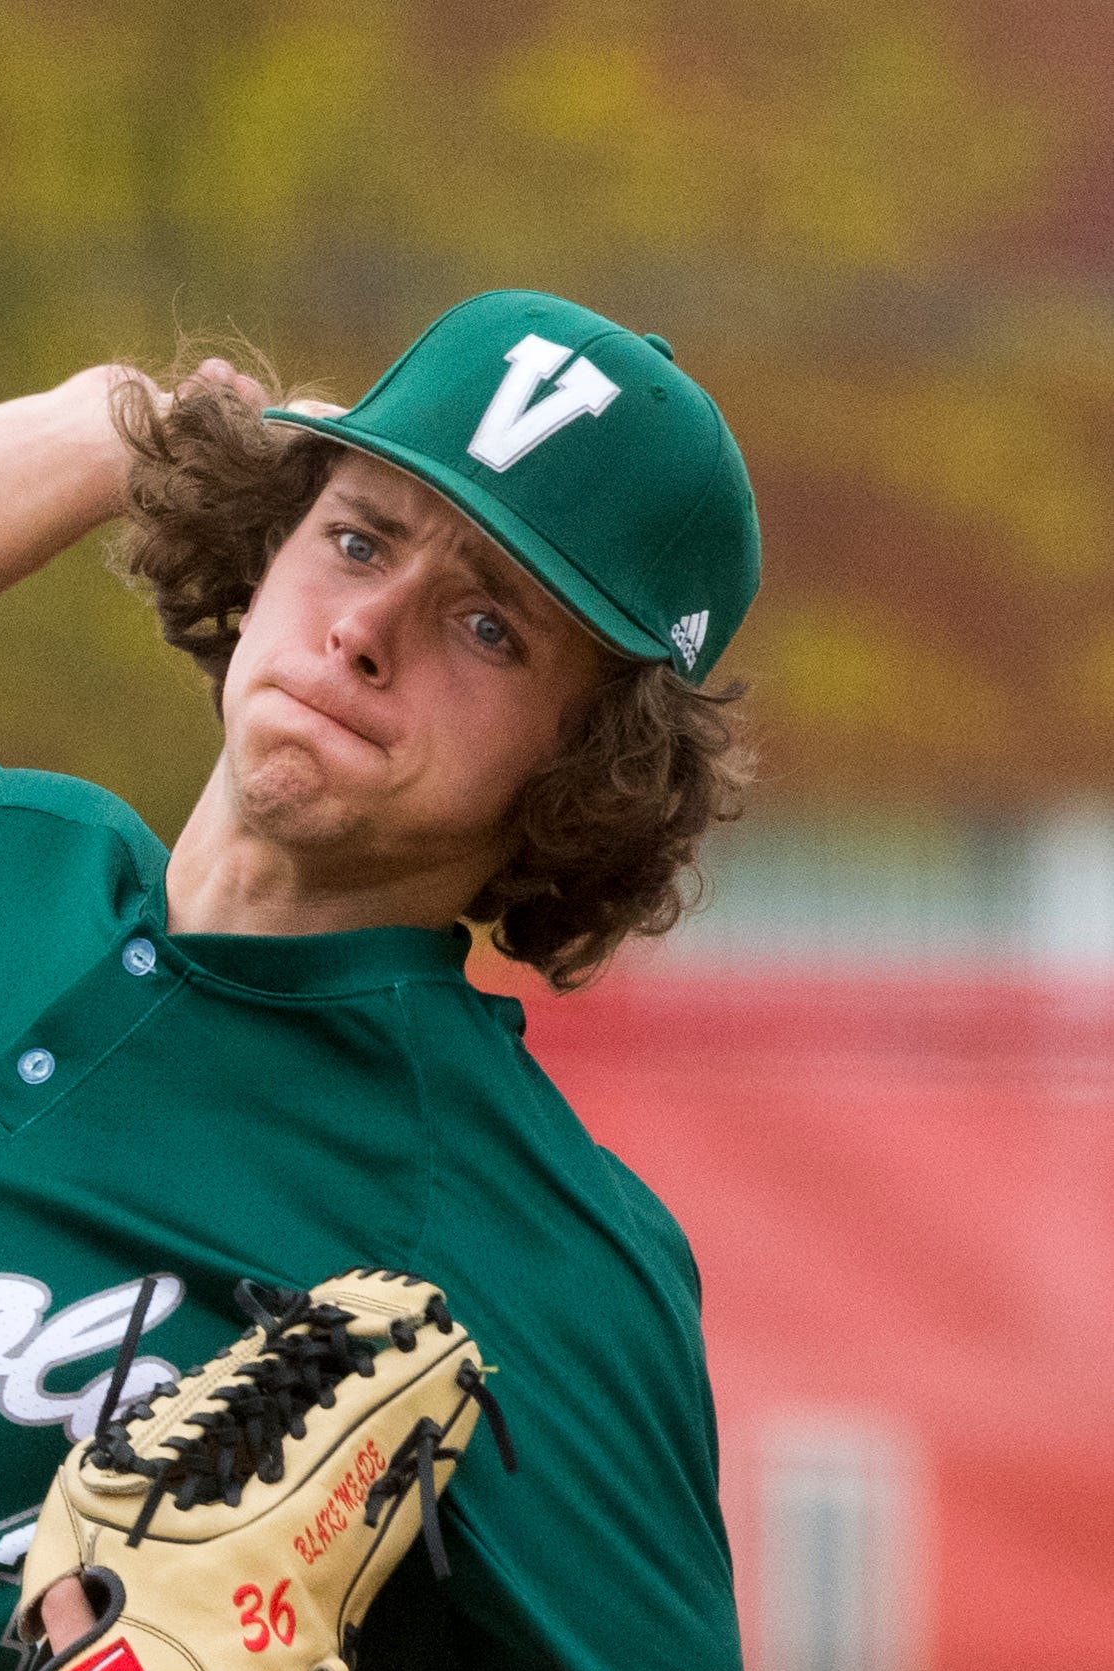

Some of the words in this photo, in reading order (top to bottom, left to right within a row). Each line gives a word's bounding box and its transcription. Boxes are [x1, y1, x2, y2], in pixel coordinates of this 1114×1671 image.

[466, 333, 622, 474] V
[671, 623, 697, 671] adidas
[292, 1498, 348, 1565] BLAKE
[333, 1439, 386, 1513] MEADE
[232, 1577, 297, 1653] 36
